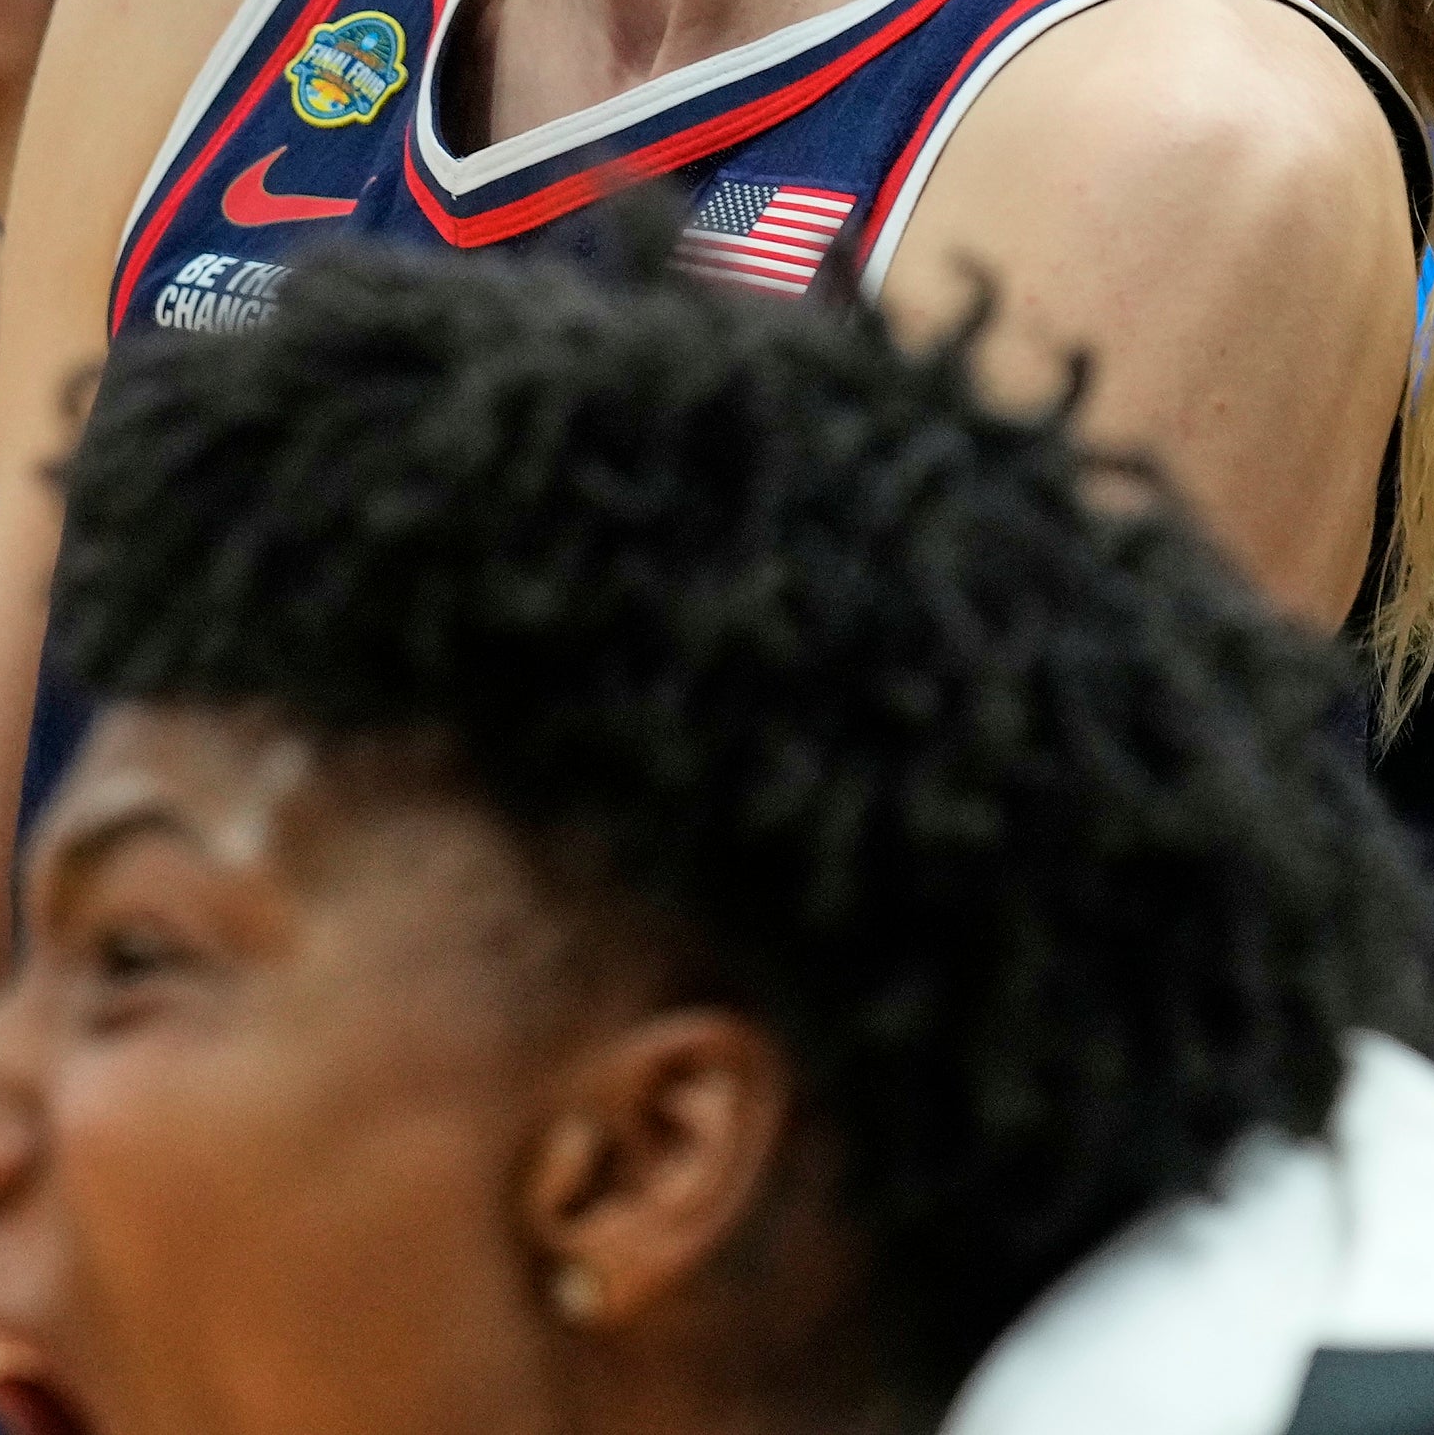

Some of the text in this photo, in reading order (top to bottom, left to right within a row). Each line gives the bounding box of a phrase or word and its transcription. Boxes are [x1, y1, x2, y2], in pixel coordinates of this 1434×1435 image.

[302, 43, 387, 103] FINAL FOUR
[175, 253, 239, 289] BE
